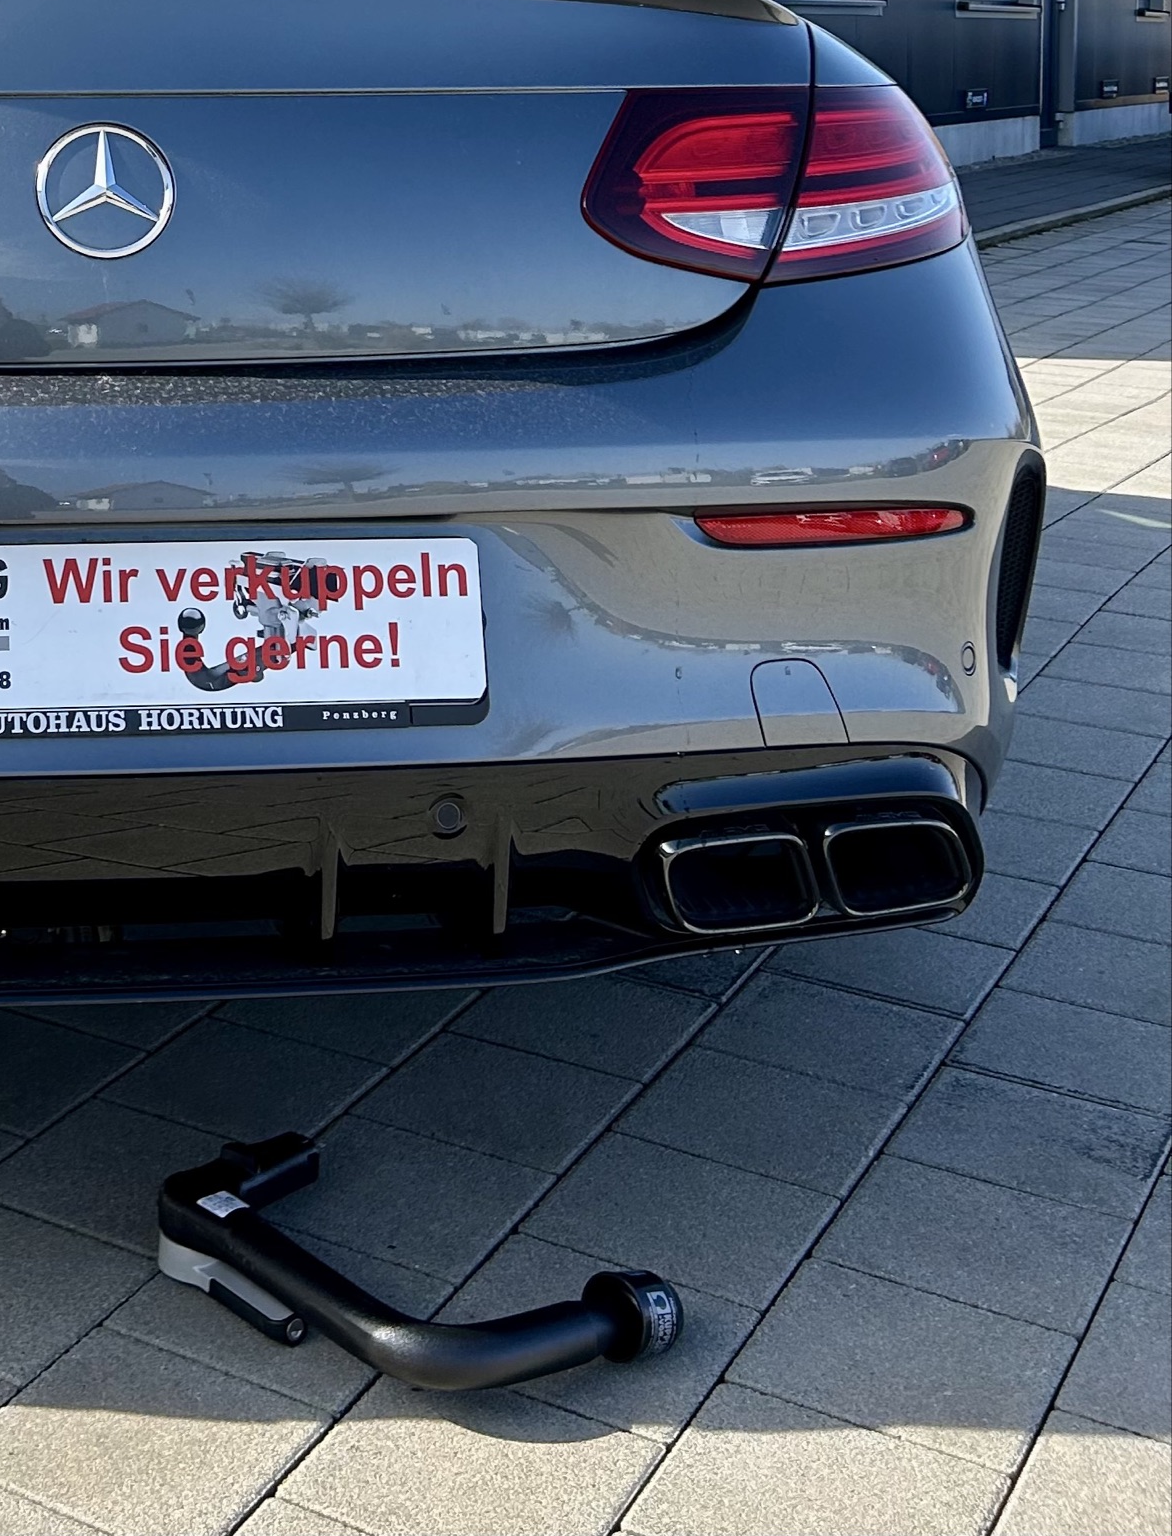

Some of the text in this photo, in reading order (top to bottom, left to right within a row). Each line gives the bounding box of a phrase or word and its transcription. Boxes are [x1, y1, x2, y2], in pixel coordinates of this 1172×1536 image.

[42, 552, 468, 611] Wir verkuppeln
[118, 622, 399, 684] Sie gerne!
[138, 706, 284, 731] HORNUNG
[322, 709, 398, 721] Penzberg
